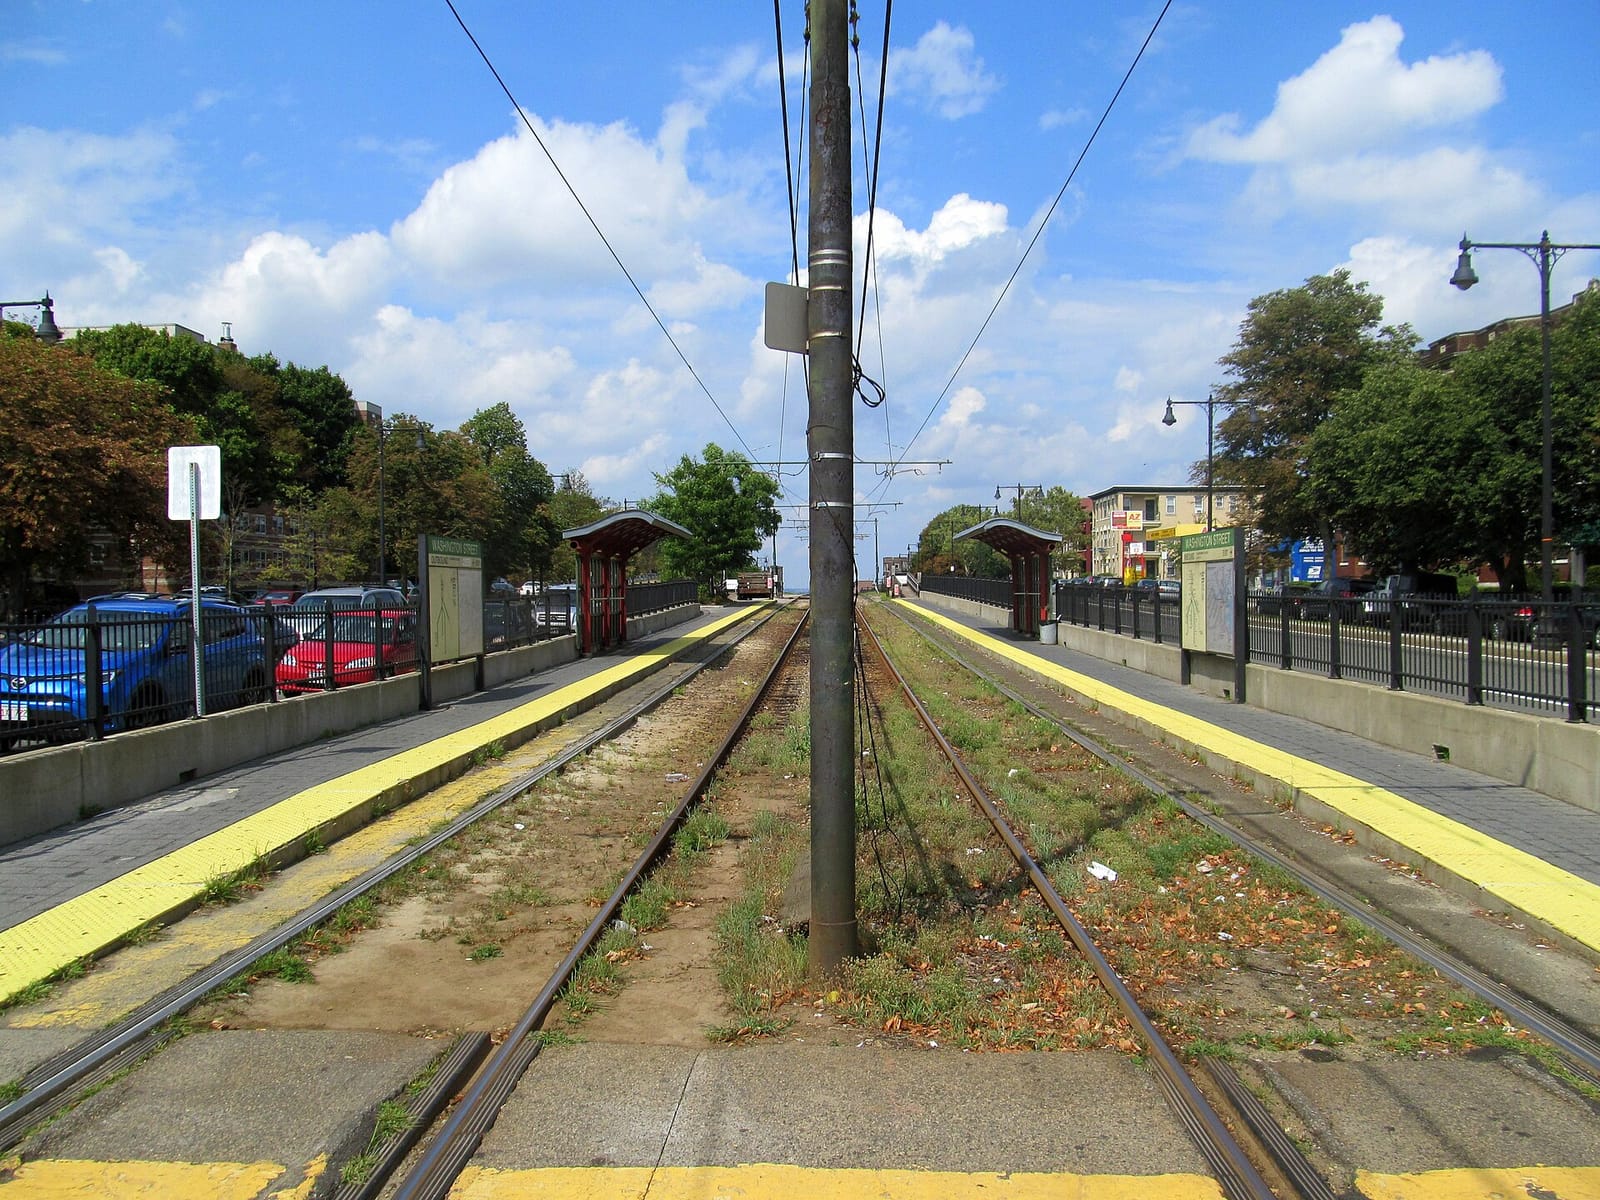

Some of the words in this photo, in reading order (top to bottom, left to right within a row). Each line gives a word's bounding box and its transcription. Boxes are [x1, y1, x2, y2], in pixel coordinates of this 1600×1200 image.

[431, 540, 463, 554] WASHINGTON
[463, 542, 479, 555] STREET
[1185, 536, 1212, 550] WASHINGTON
[1213, 532, 1231, 546] STREET
